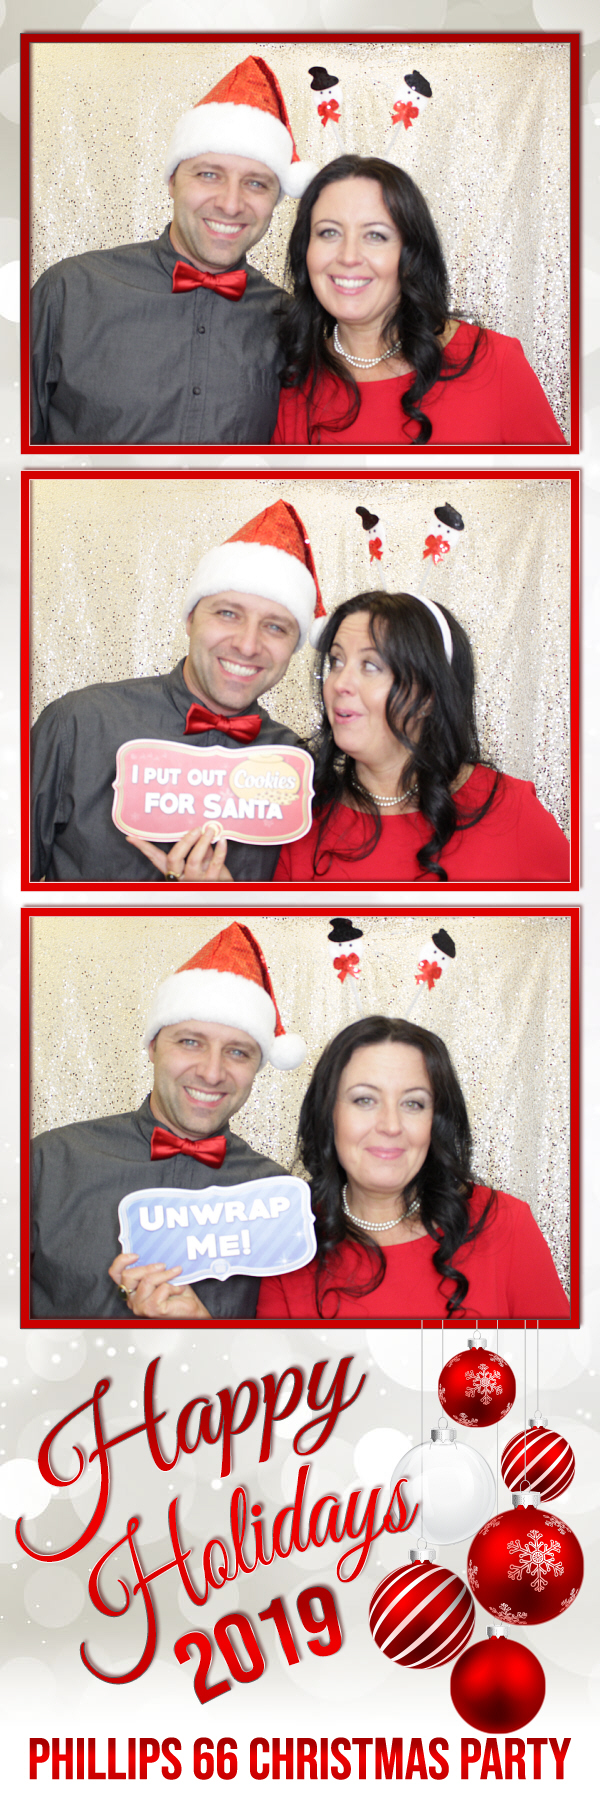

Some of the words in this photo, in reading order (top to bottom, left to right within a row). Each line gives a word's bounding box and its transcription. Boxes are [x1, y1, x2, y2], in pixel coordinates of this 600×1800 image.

[131, 764, 139, 784] I
[143, 767, 181, 785] PUT
[187, 769, 227, 787] OUT
[233, 769, 297, 790] Cookies
[144, 792, 195, 815] FOR
[203, 793, 283, 820] SANTA
[139, 1196, 291, 1231] UNWRAP
[186, 1229, 252, 1260] ME!
